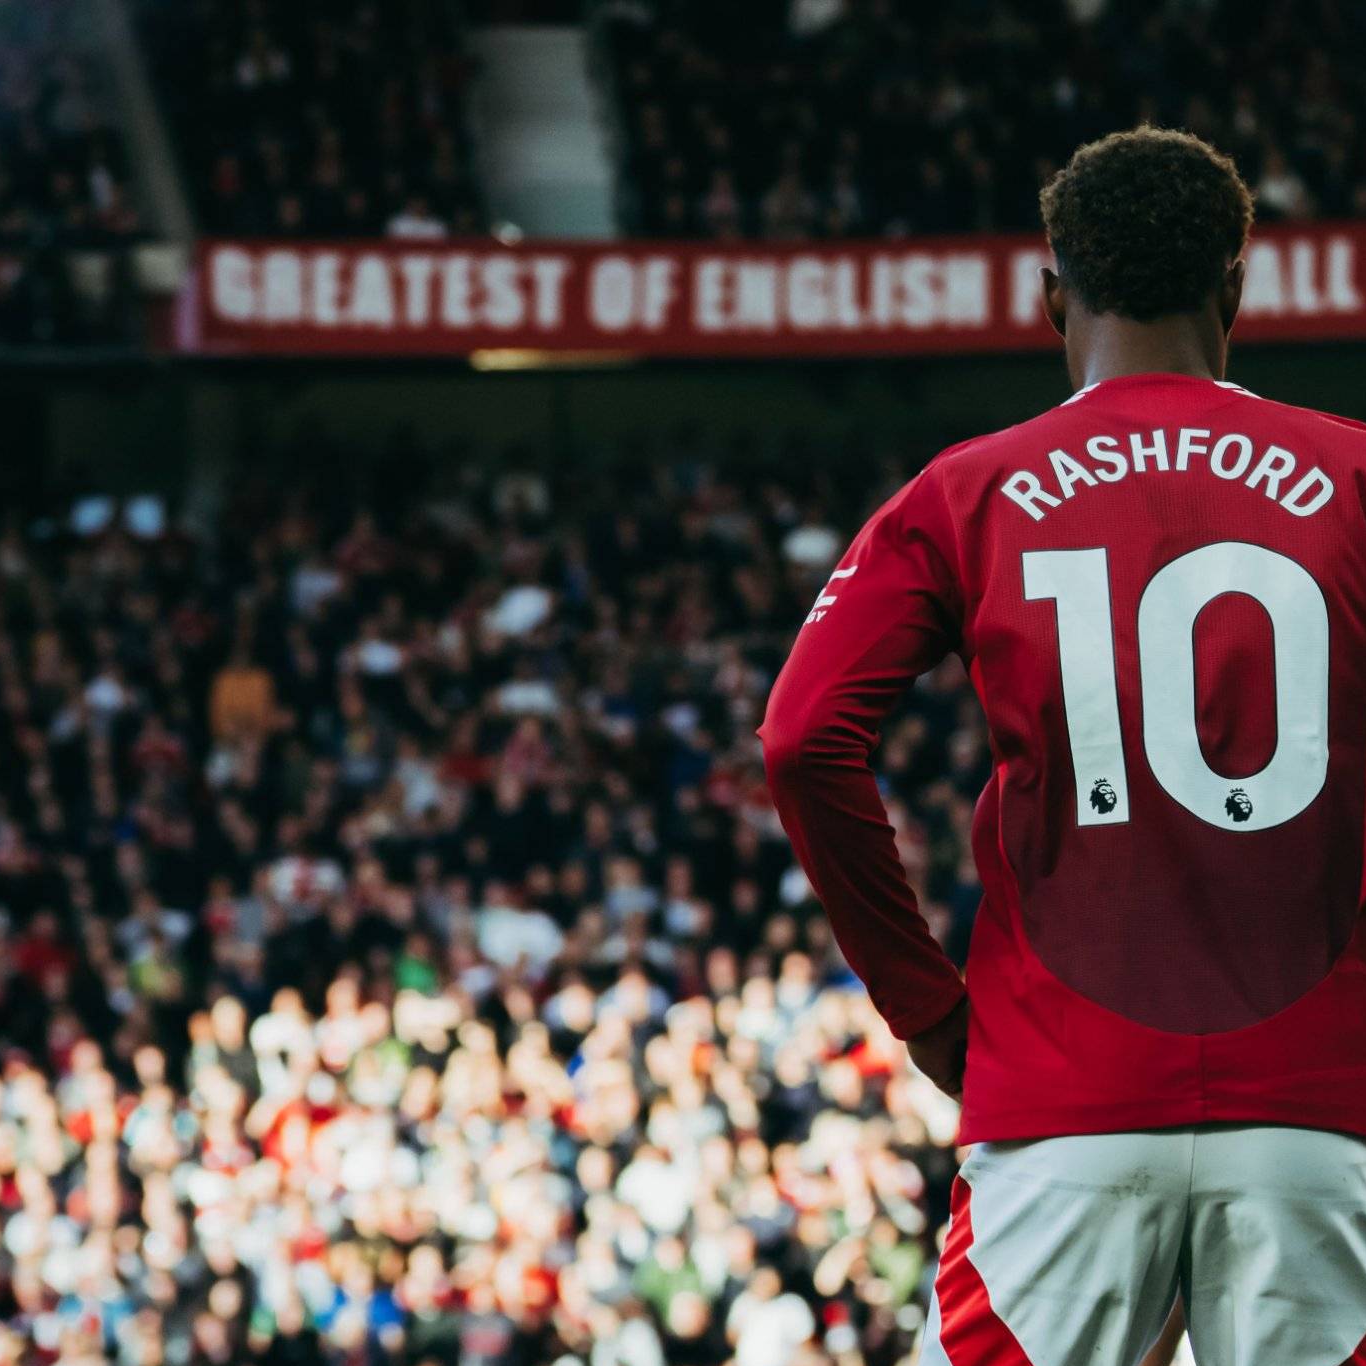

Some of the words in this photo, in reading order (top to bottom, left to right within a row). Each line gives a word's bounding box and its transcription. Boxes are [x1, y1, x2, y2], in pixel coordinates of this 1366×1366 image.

[210, 245, 569, 330] GREATEST
[590, 256, 679, 331] OF
[695, 252, 991, 331] ENGLISH
[1009, 236, 1365, 328] FALL
[1001, 427, 1335, 522] RASHFORD
[1021, 540, 1330, 833] 10
